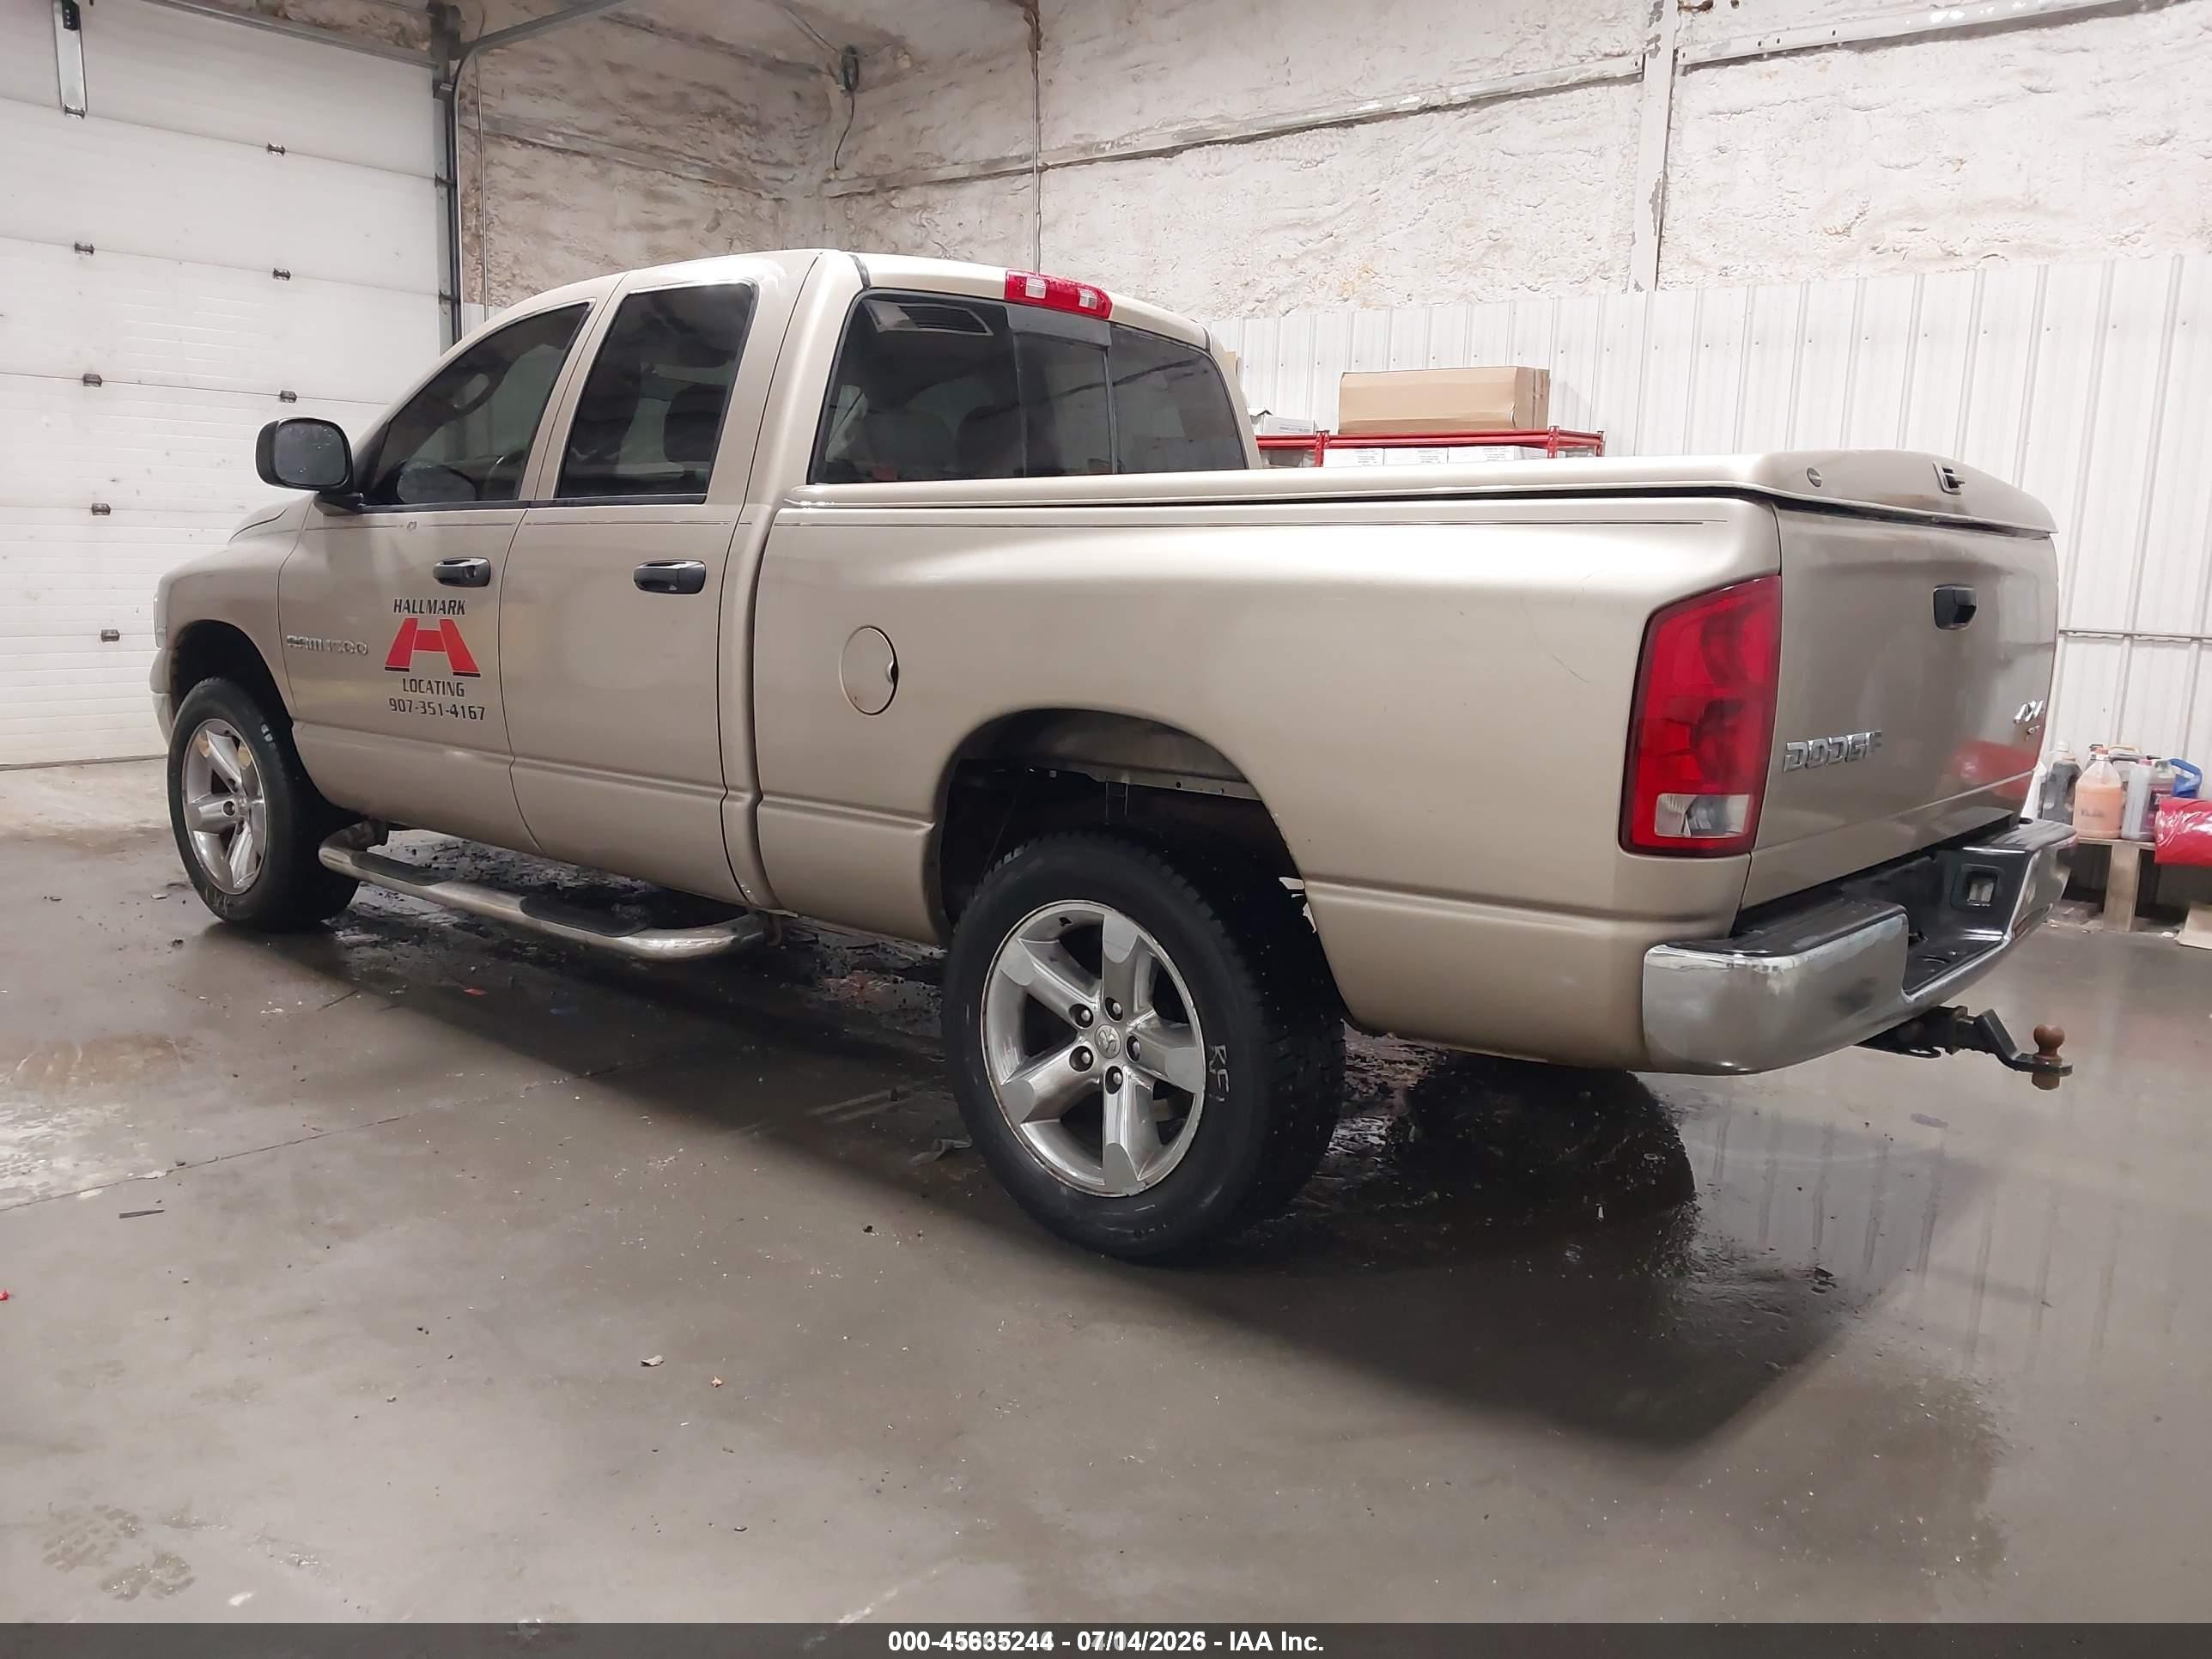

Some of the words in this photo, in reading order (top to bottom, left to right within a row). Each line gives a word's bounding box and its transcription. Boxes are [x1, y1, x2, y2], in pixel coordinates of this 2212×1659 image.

[392, 598, 467, 616] HALLMARK
[402, 678, 465, 697] LOCATING
[389, 697, 486, 721] 907-351-4167
[1783, 730, 1882, 773] DODGE
